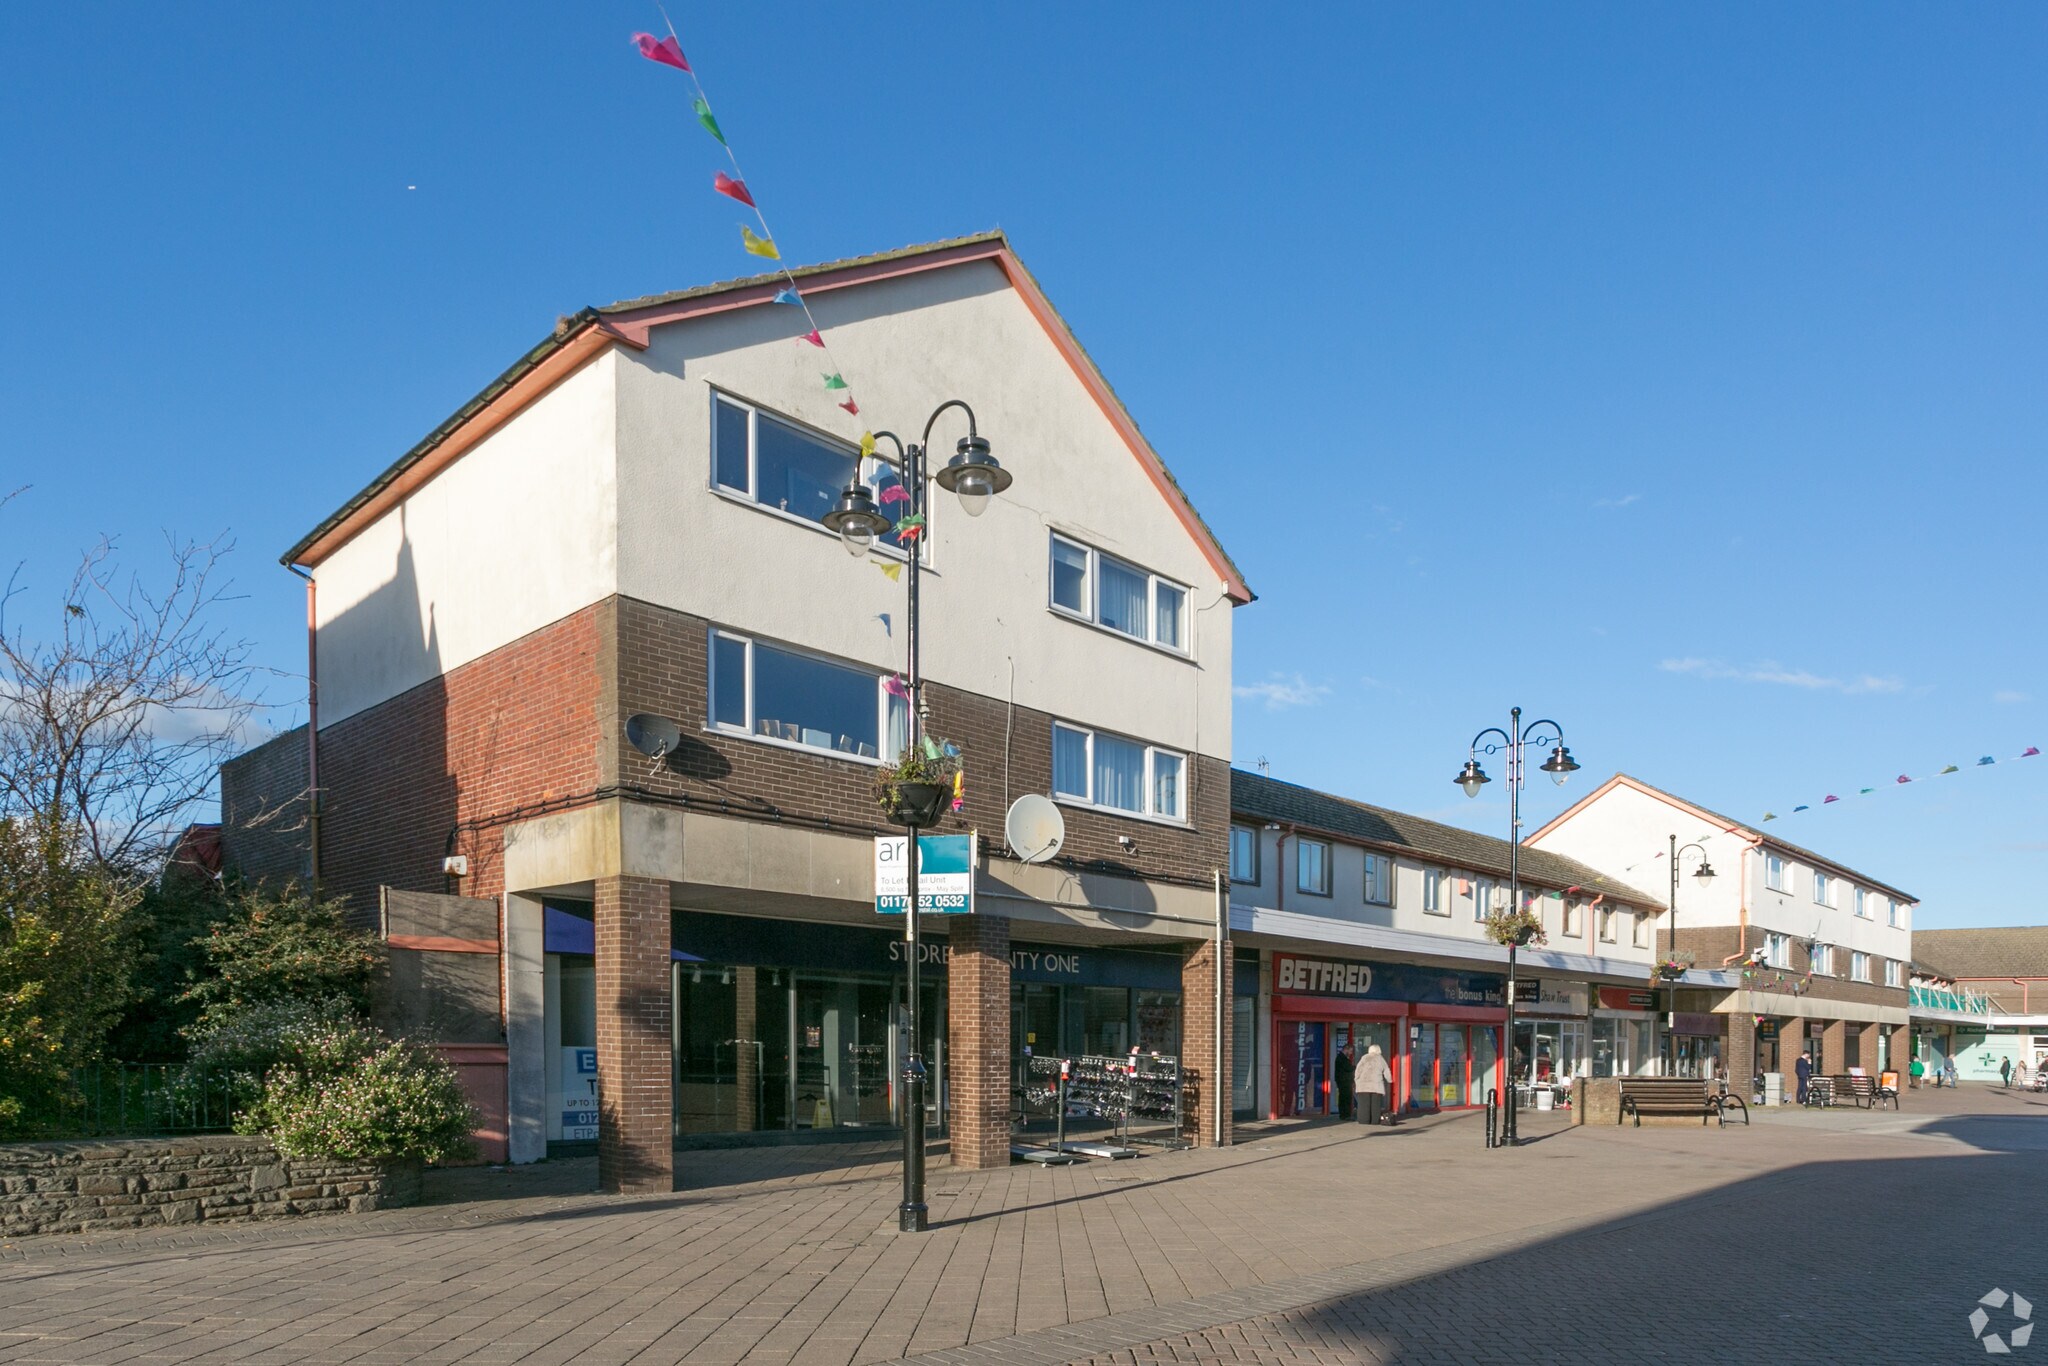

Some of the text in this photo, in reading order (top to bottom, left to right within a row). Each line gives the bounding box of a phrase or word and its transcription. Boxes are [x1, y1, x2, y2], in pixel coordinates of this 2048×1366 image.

[879, 842, 905, 862] ar
[929, 876, 946, 884] Unit
[880, 895, 965, 908] 0117 52 0532
[1010, 951, 1040, 971] NTY
[1044, 954, 1080, 973] ONE
[1278, 958, 1372, 993] BETFRED
[1458, 987, 1483, 1001] bonus
[1485, 989, 1502, 1004] king
[1556, 990, 1571, 1003] Trust
[582, 1053, 596, 1070] E
[1298, 1021, 1306, 1111] BETFRED
[586, 1078, 597, 1096] T
[567, 1099, 578, 1107] UP
[579, 1099, 590, 1107] TO
[578, 1112, 599, 1124] 012
